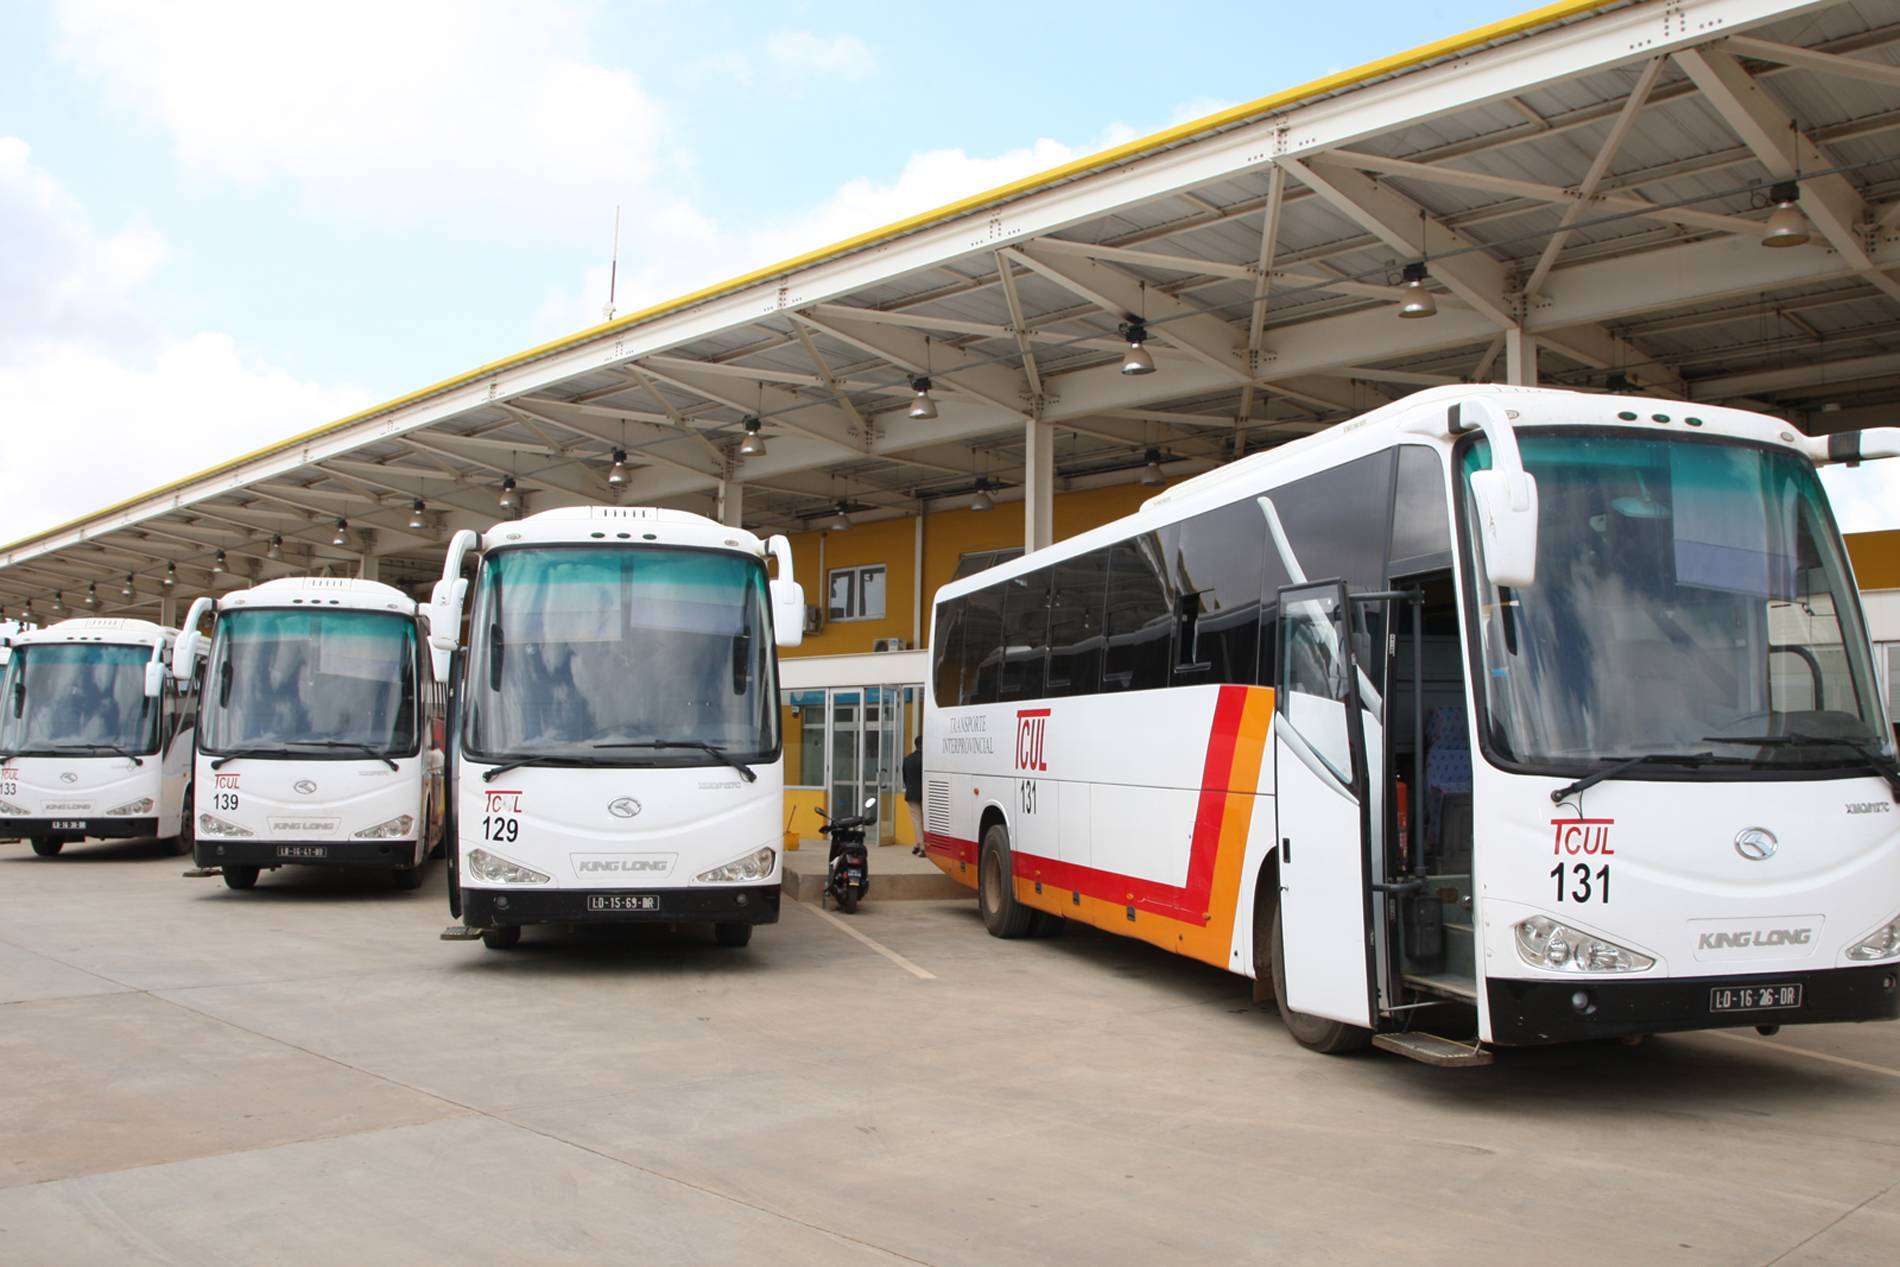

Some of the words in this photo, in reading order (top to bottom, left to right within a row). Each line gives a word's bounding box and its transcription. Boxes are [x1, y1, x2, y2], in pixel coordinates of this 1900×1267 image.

[950, 715, 987, 733] TRANSPORTE
[942, 736, 994, 754] INTERPROVINCIAL
[1015, 708, 1051, 771] TCUL
[215, 773, 240, 789] TCUL
[213, 793, 239, 811] 139
[485, 790, 523, 813] TCL
[1021, 780, 1037, 815] 131
[273, 822, 300, 830] KING
[302, 822, 335, 830] LONG
[482, 816, 519, 843] 129
[1550, 818, 1615, 856] TCUL
[580, 861, 620, 872] KING
[621, 861, 667, 872] LONG
[1550, 862, 1610, 904] 131
[1699, 930, 1752, 950] KING
[1752, 928, 1812, 946] LONG
